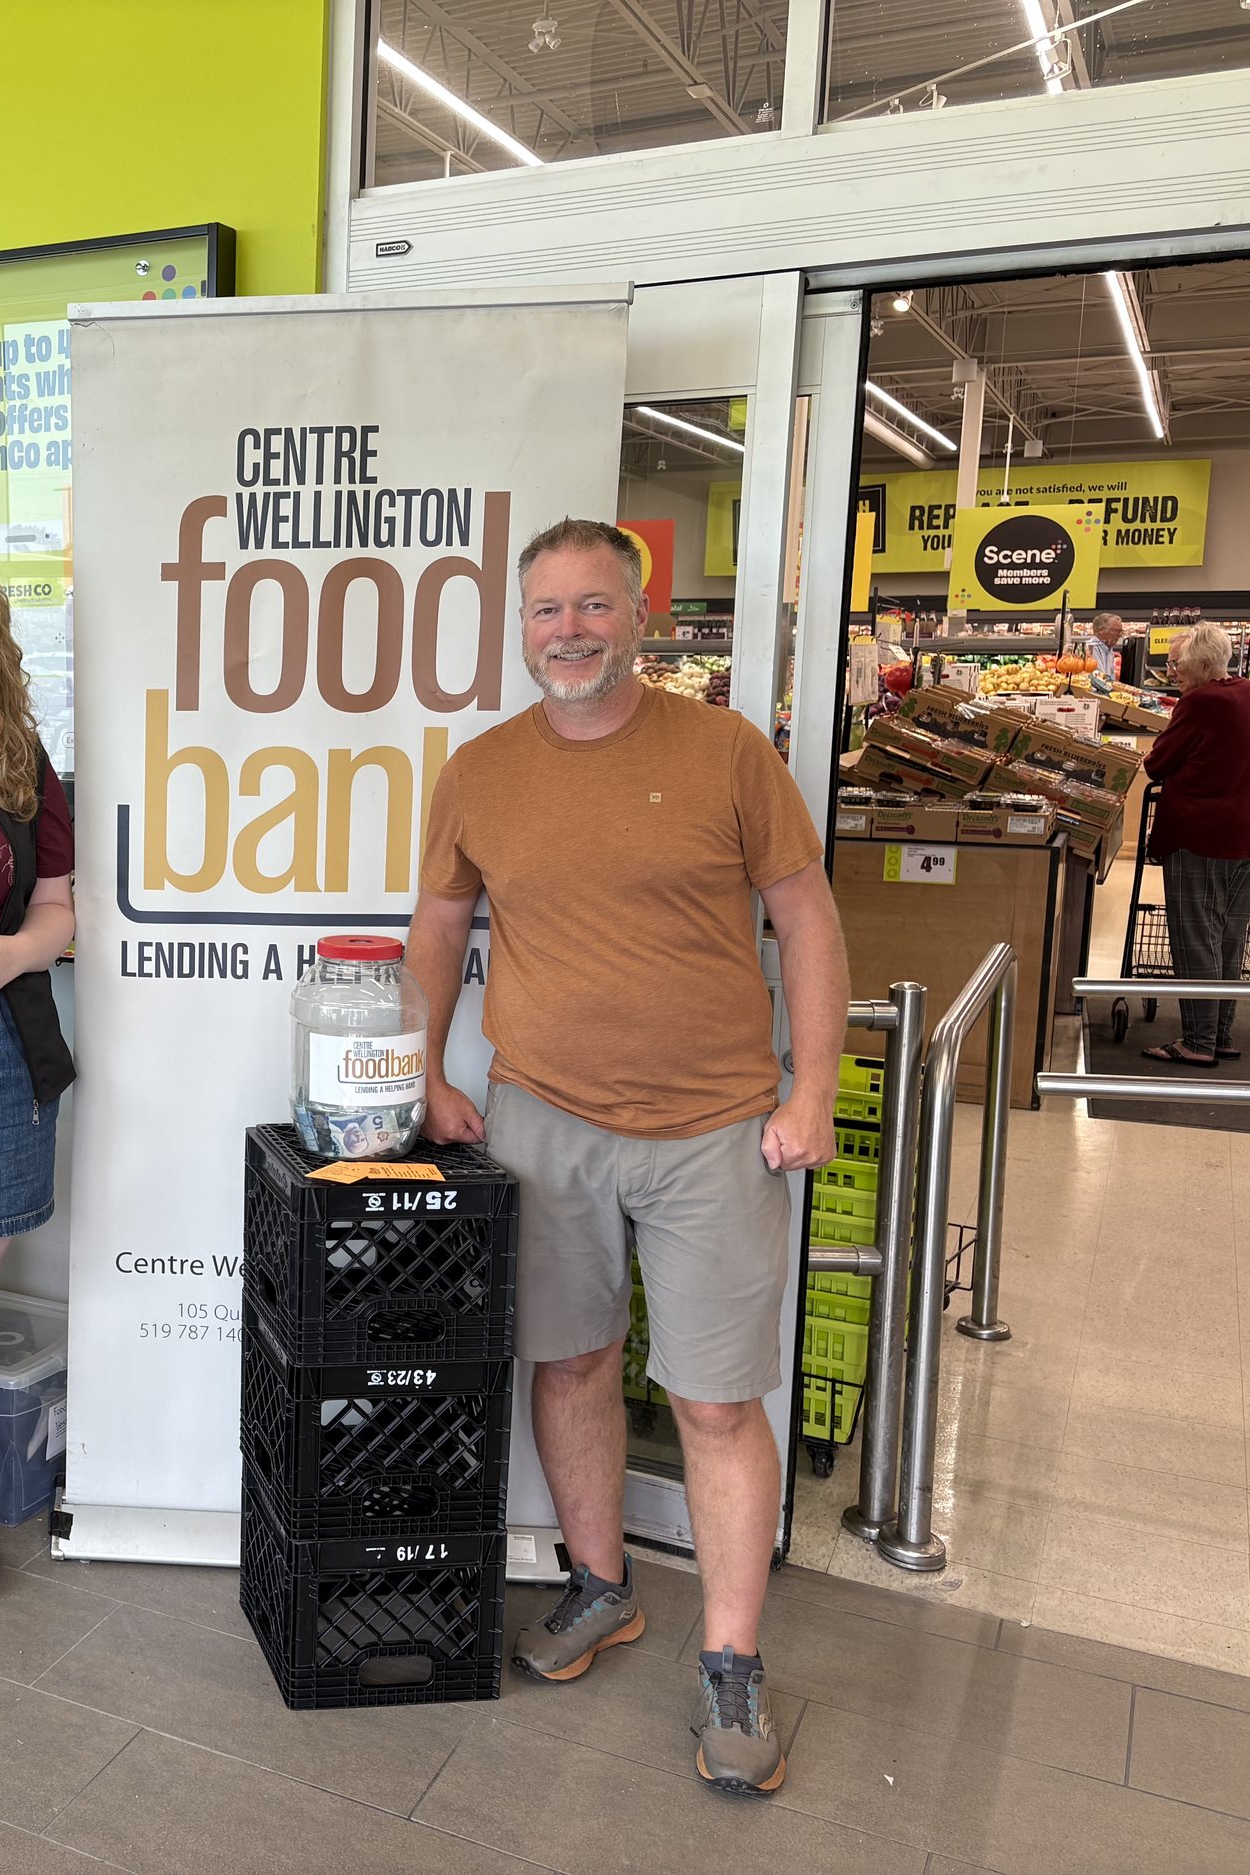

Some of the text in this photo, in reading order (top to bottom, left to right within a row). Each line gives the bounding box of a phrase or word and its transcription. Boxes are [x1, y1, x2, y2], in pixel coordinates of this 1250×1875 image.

[24, 333, 52, 364] to
[236, 425, 380, 488] CENTRE
[1015, 485, 1034, 495] not
[1035, 482, 1086, 495] satisfied,
[1087, 484, 1105, 492] we
[1106, 481, 1127, 492] will
[235, 487, 472, 550] WELLINGTON
[1068, 494, 1179, 525] FUND
[1115, 527, 1178, 546] MONEY
[983, 544, 1056, 565] Scene
[993, 575, 1051, 586] save more
[997, 567, 1049, 579] Members
[160, 490, 512, 714] food
[670, 604, 683, 612] alal
[1040, 743, 1063, 755] FRESH
[121, 940, 250, 981] LENDING
[262, 942, 284, 981] A
[353, 1041, 373, 1050] CENTRE
[353, 1049, 386, 1058] WELLINGTON
[342, 1048, 425, 1079] foodbank
[354, 1085, 379, 1094] LENDING
[385, 1083, 405, 1093] HELPING
[115, 1251, 205, 1276] Centre
[177, 1302, 240, 1322] 105 Qu
[139, 1322, 172, 1339] 519
[177, 1323, 210, 1341] 787
[387, 1369, 438, 1386] 43/23
